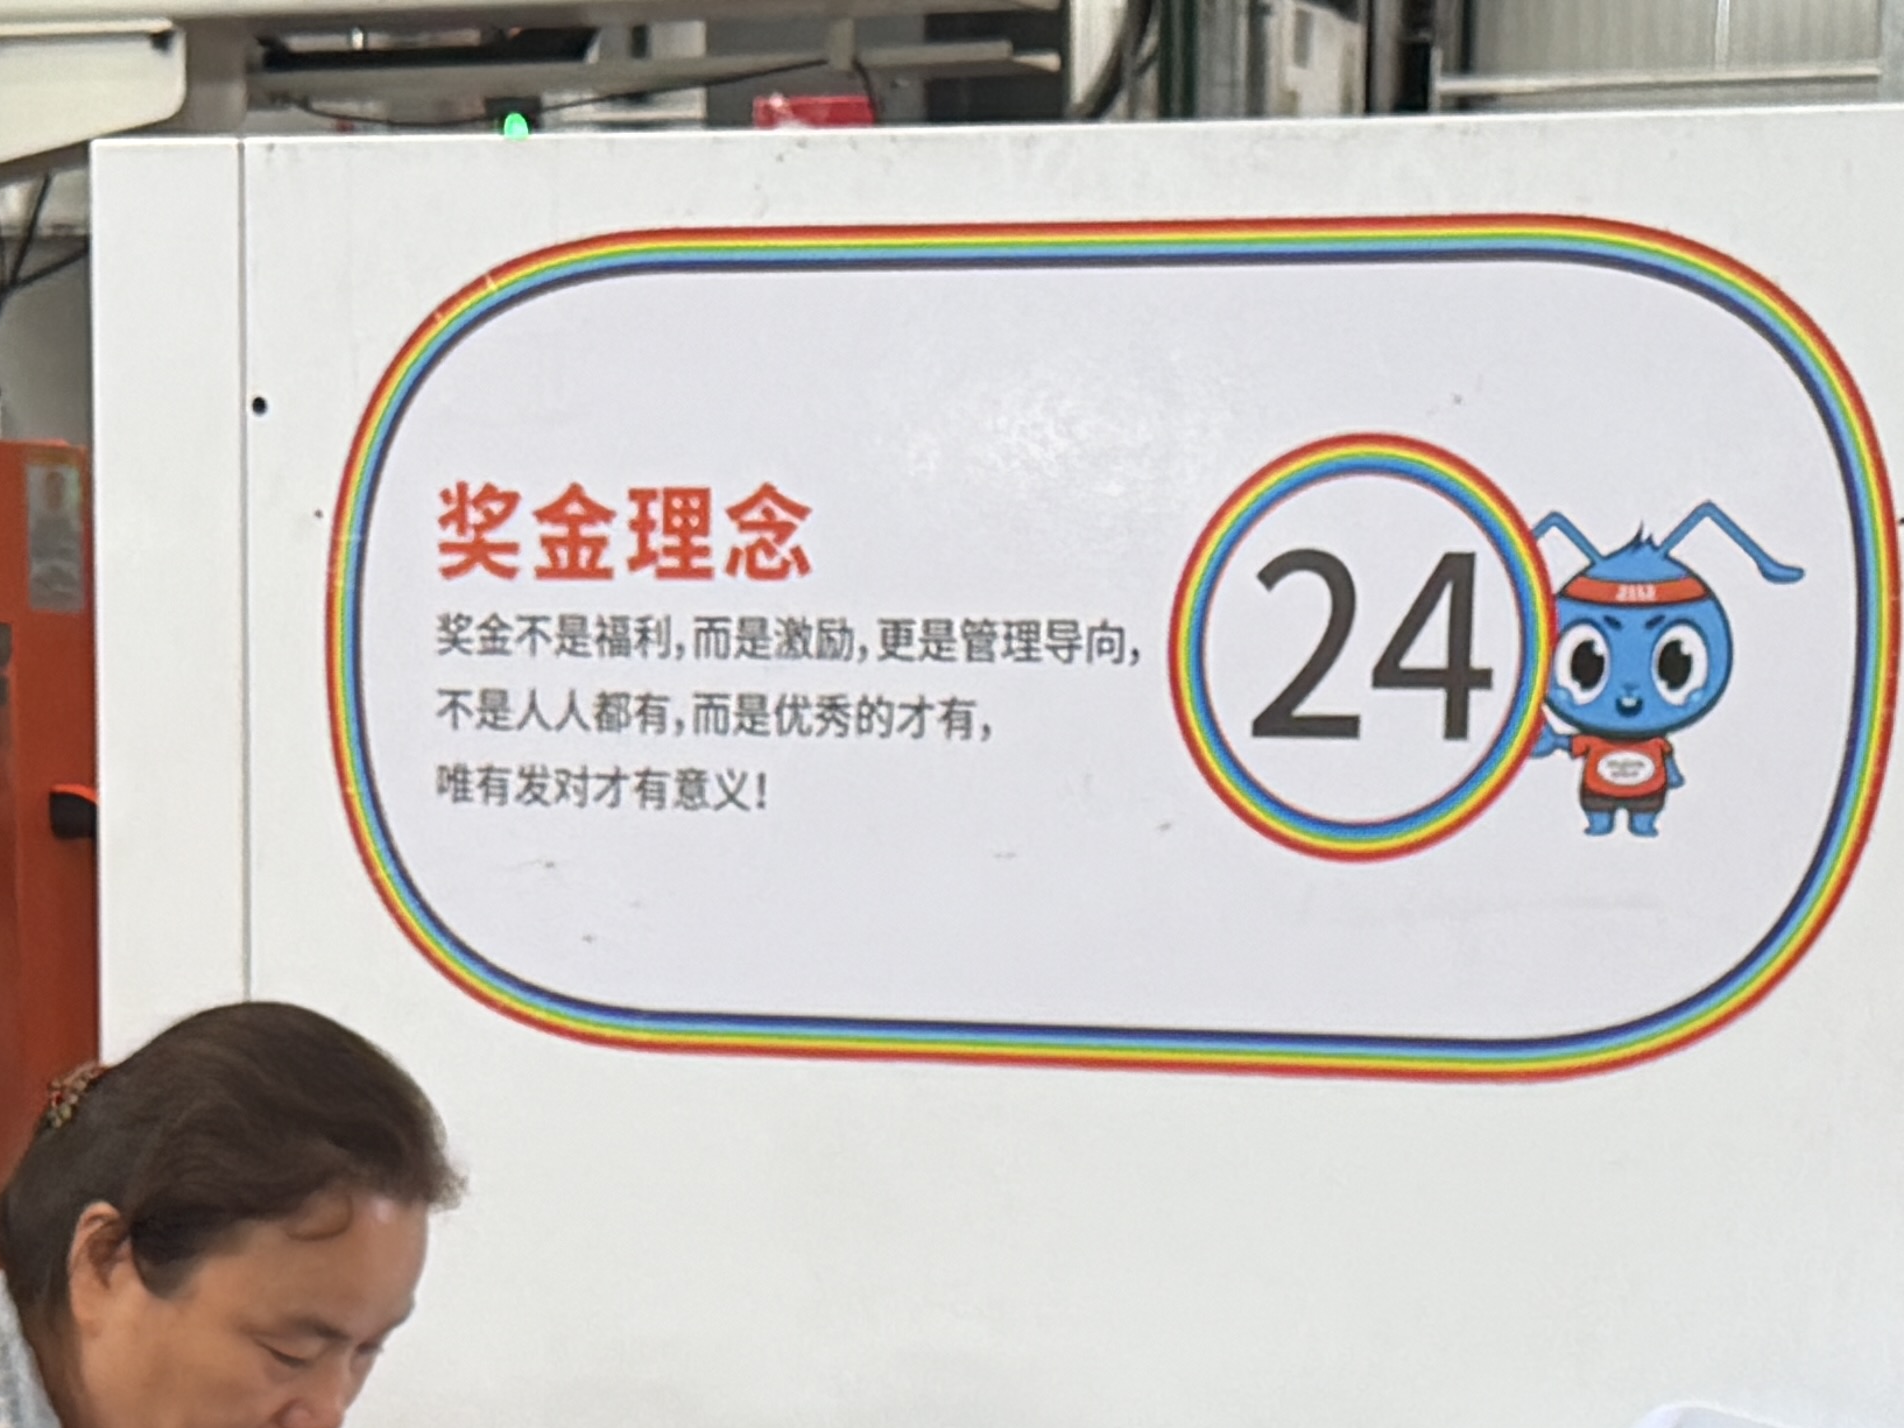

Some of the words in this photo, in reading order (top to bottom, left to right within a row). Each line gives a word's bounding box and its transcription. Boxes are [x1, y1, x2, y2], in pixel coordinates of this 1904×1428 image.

[437, 481, 814, 583] 奖金理念
[1251, 547, 1494, 741] 24
